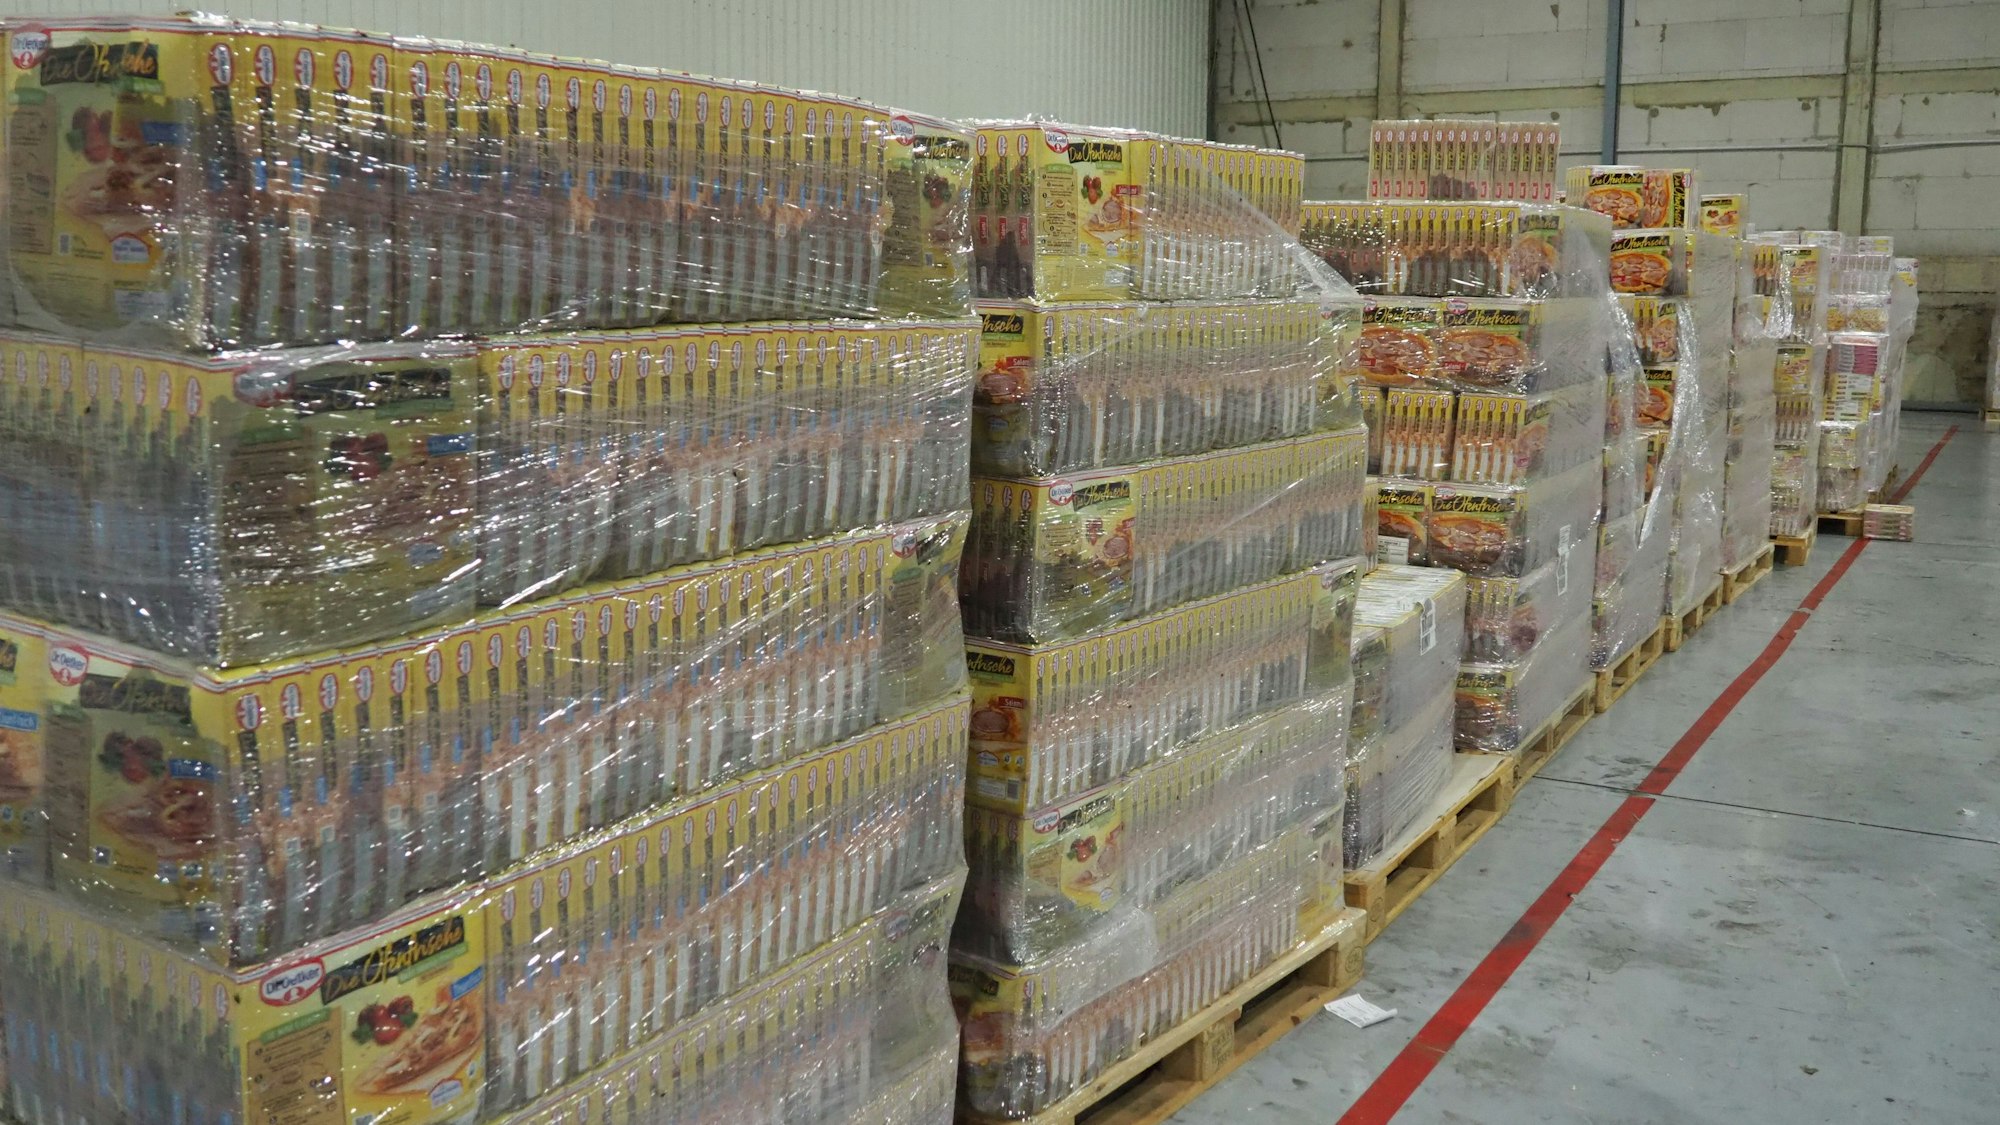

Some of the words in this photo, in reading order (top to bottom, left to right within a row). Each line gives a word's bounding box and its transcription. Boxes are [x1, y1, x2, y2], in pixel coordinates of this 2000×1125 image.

[1434, 498, 1453, 510] Die
[325, 971, 361, 1000] Die
[361, 914, 463, 986] Ofenfrische
[281, 967, 321, 987] Oetker
